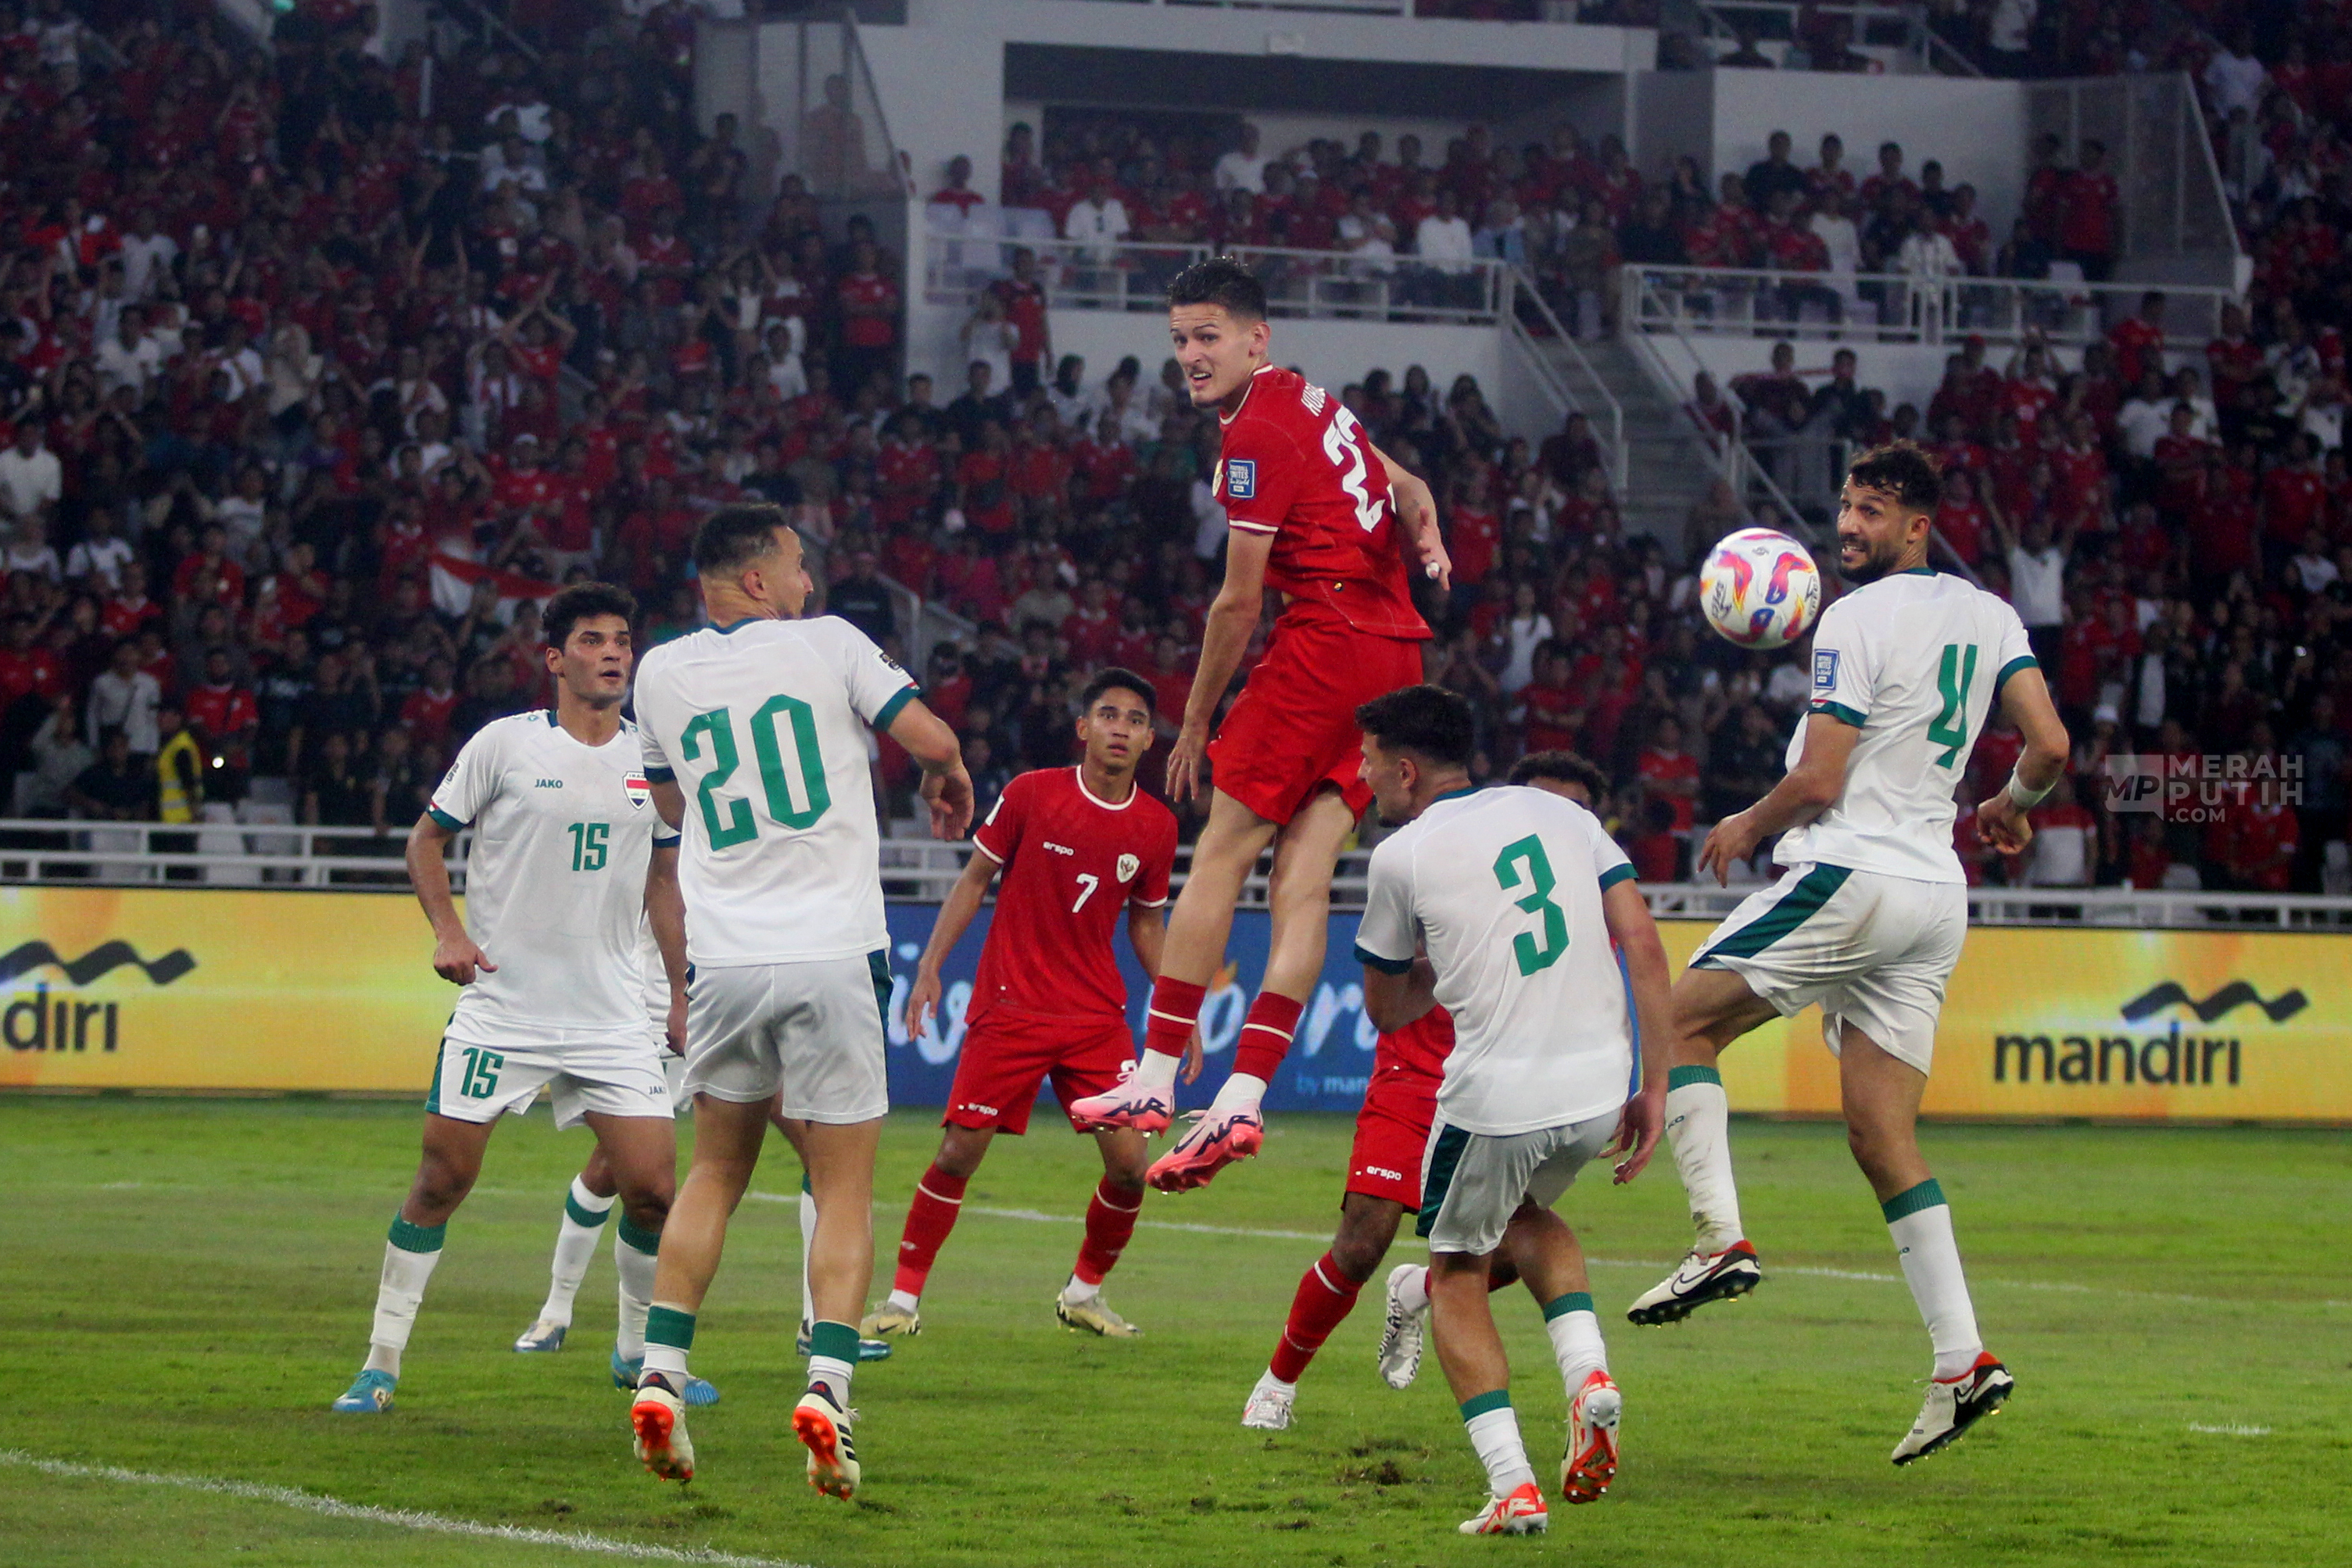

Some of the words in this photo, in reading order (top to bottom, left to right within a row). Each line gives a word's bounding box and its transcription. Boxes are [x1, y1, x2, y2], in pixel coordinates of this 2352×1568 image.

[1927, 643, 1978, 770] 4
[535, 779, 564, 789] JAKO
[680, 693, 832, 852] 20
[567, 823, 610, 871] 15
[1072, 872, 1099, 913] 7
[1492, 832, 1570, 977] 3
[2, 981, 117, 1051] diri
[460, 1047, 504, 1099] 15
[1993, 1019, 2240, 1086] mandiri
[1104, 1097, 1167, 1118] AIR
[1366, 1165, 1402, 1181] erspo
